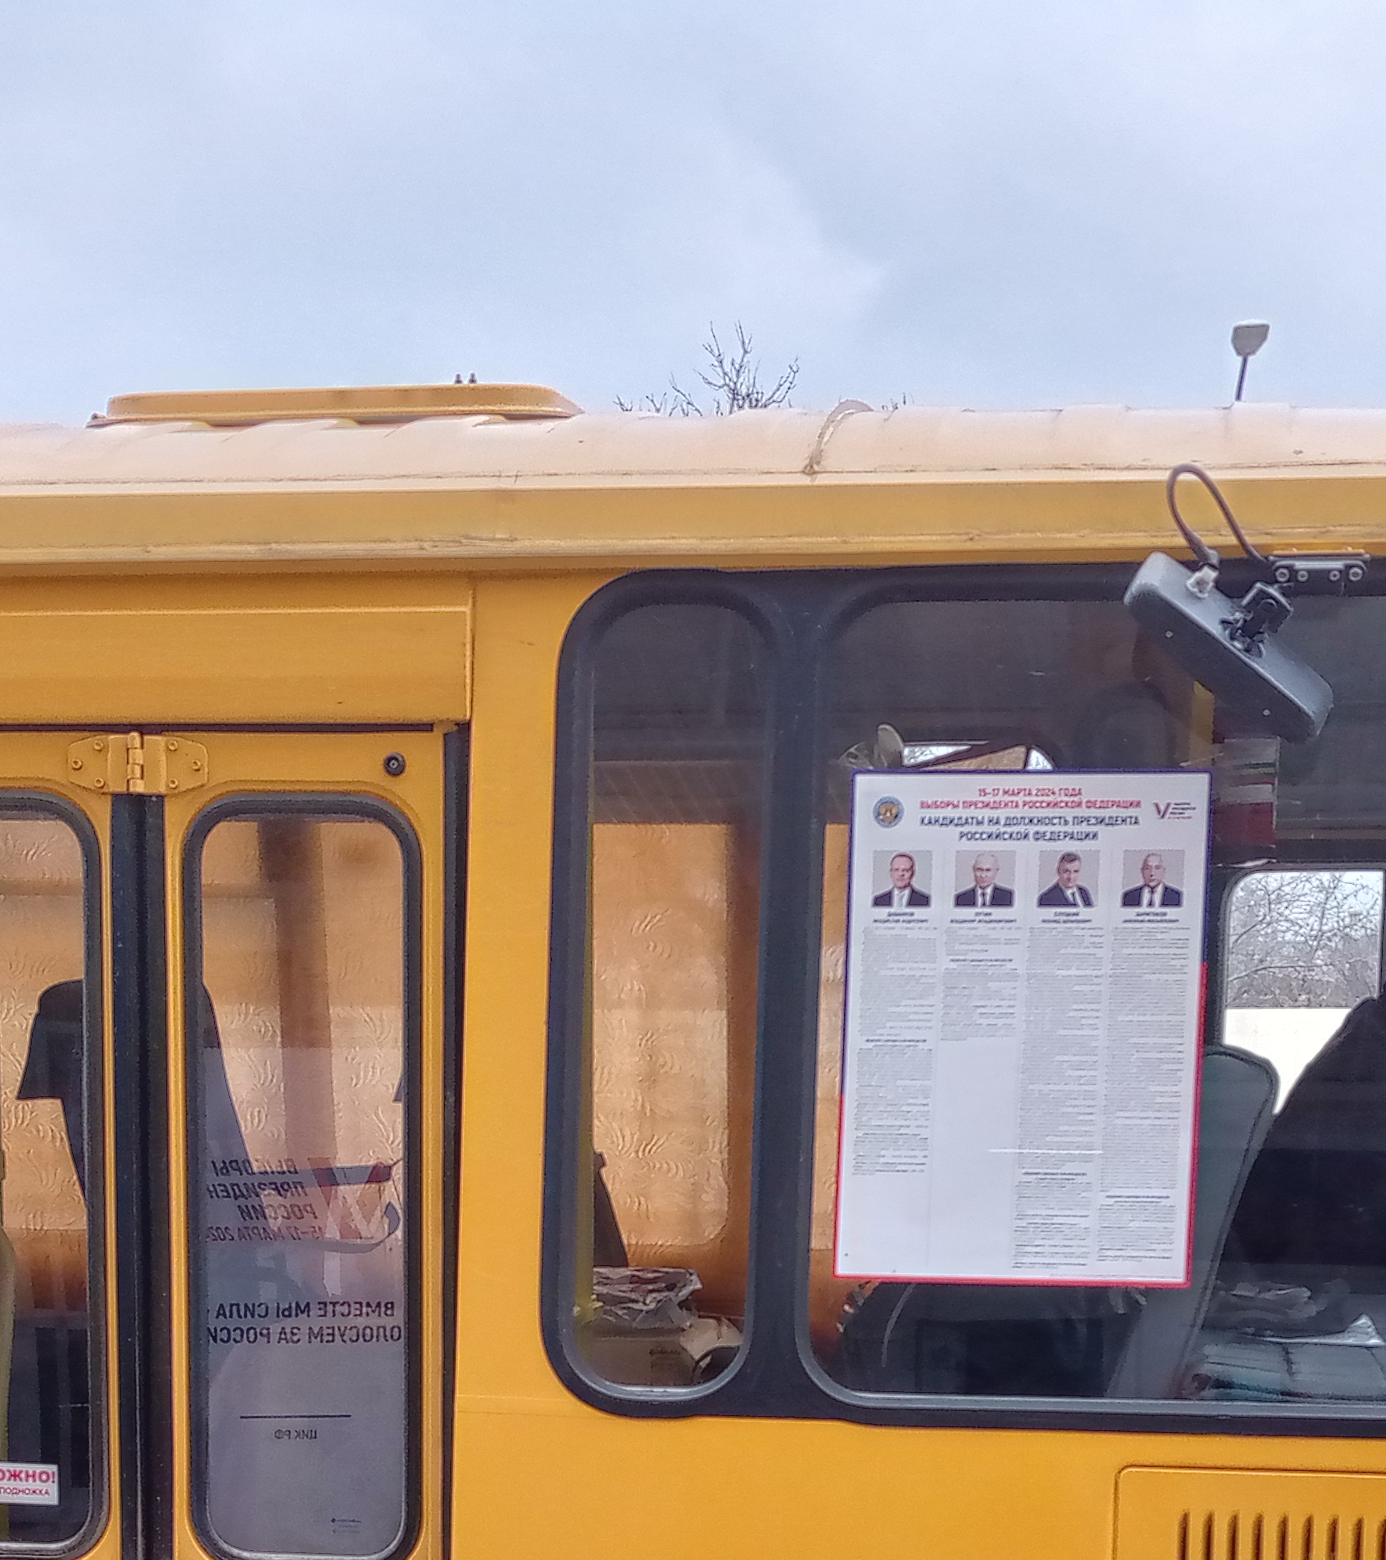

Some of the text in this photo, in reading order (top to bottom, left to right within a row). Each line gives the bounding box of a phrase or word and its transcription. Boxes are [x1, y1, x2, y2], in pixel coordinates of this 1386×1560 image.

[1002, 788, 1032, 797] МАРТА
[1034, 787, 1056, 797] 2024
[1058, 787, 1083, 797] ГОДА
[919, 798, 1142, 810] ВЫБОРЫ ПРЕЗИДЕНТА РОССИЙСКОЙ ФЕДЕРАЦИИ
[919, 815, 1141, 827] КАНДИДАТЫ НА ДОЛЖНОСТЬ ПРЕЗИДЕНТА
[958, 828, 1099, 842] РОССИЙСКОЙ ФЕДЕРАЦИИ
